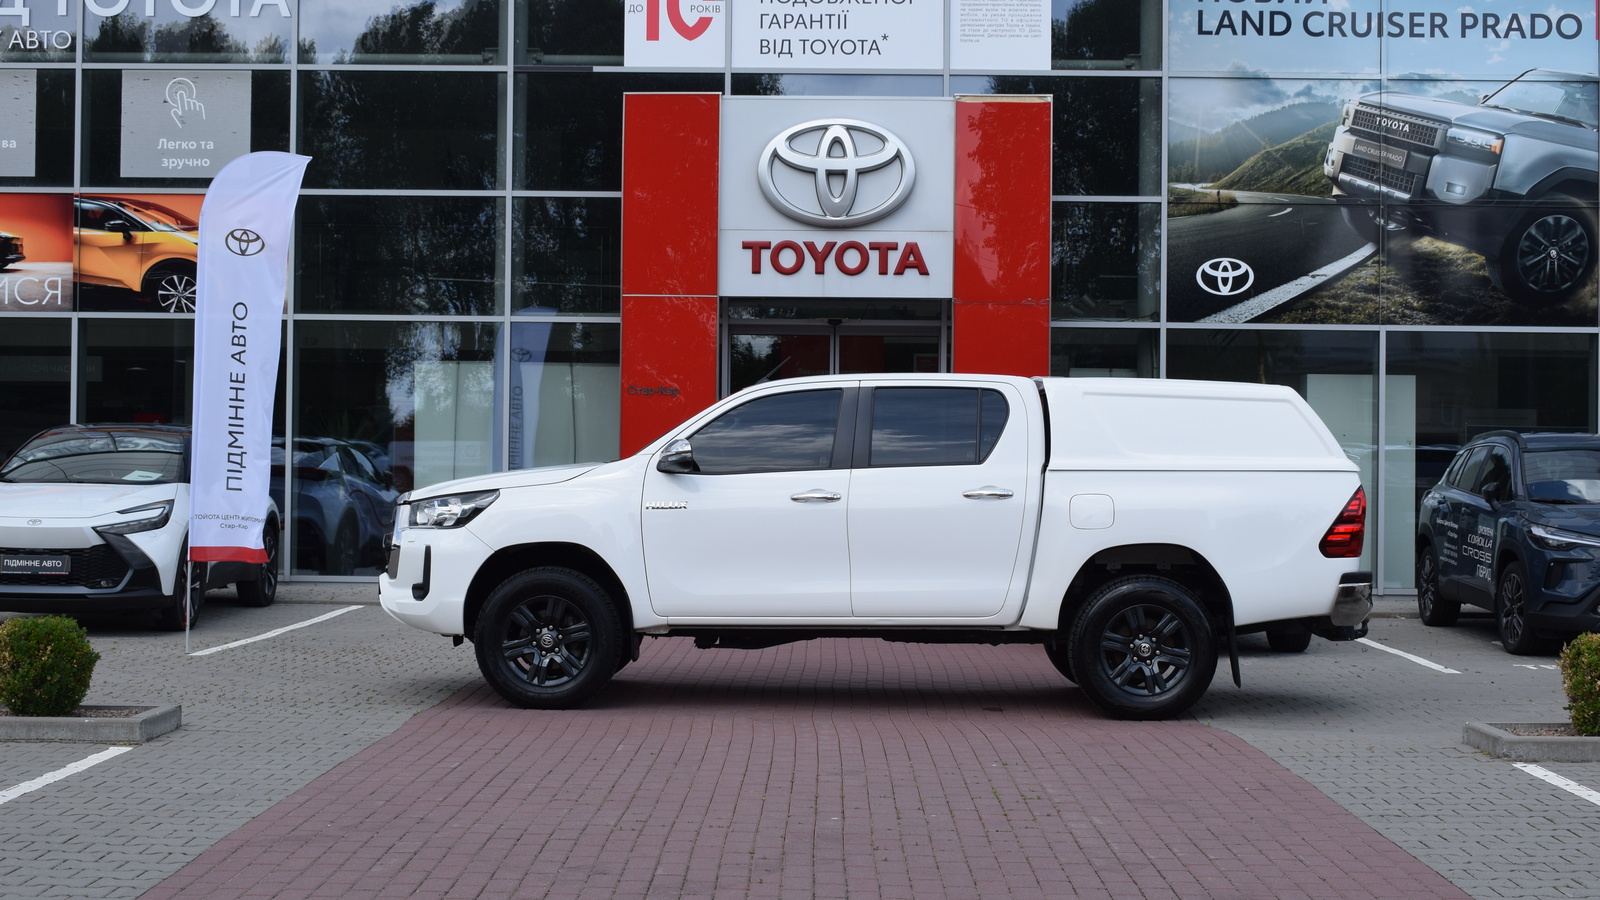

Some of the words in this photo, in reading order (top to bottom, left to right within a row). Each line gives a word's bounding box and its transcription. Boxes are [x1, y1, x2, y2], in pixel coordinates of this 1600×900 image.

[628, 4, 644, 14] ДО
[690, 5, 721, 13] РОКІВ
[760, 10, 849, 29] ГАРАНТІЇ
[1197, 10, 1292, 37] LAND
[1302, 11, 1449, 38] CRUISER
[1460, 13, 1583, 40] PRADO
[8, 30, 73, 50] АВТО
[759, 39, 793, 58] ВІД
[1376, 117, 1410, 133] TOYOTA
[0, 139, 17, 149] ва
[157, 138, 197, 150] Легко
[200, 140, 214, 150] та
[1355, 144, 1367, 153] LAND
[1387, 153, 1403, 163] PRADO
[161, 157, 210, 169] зручно
[742, 240, 930, 276] TOYOTA
[231, 302, 248, 365] АВТО
[628, 385, 680, 397] Стар-Кар
[226, 372, 247, 491] ПІДМІННЕ
[646, 501, 688, 510] HILUX
[1467, 533, 1492, 549] COROLLA
[1462, 545, 1492, 564] CROSS
[4, 559, 41, 567] ПІДМІННЕ
[42, 560, 63, 568] АВТО
